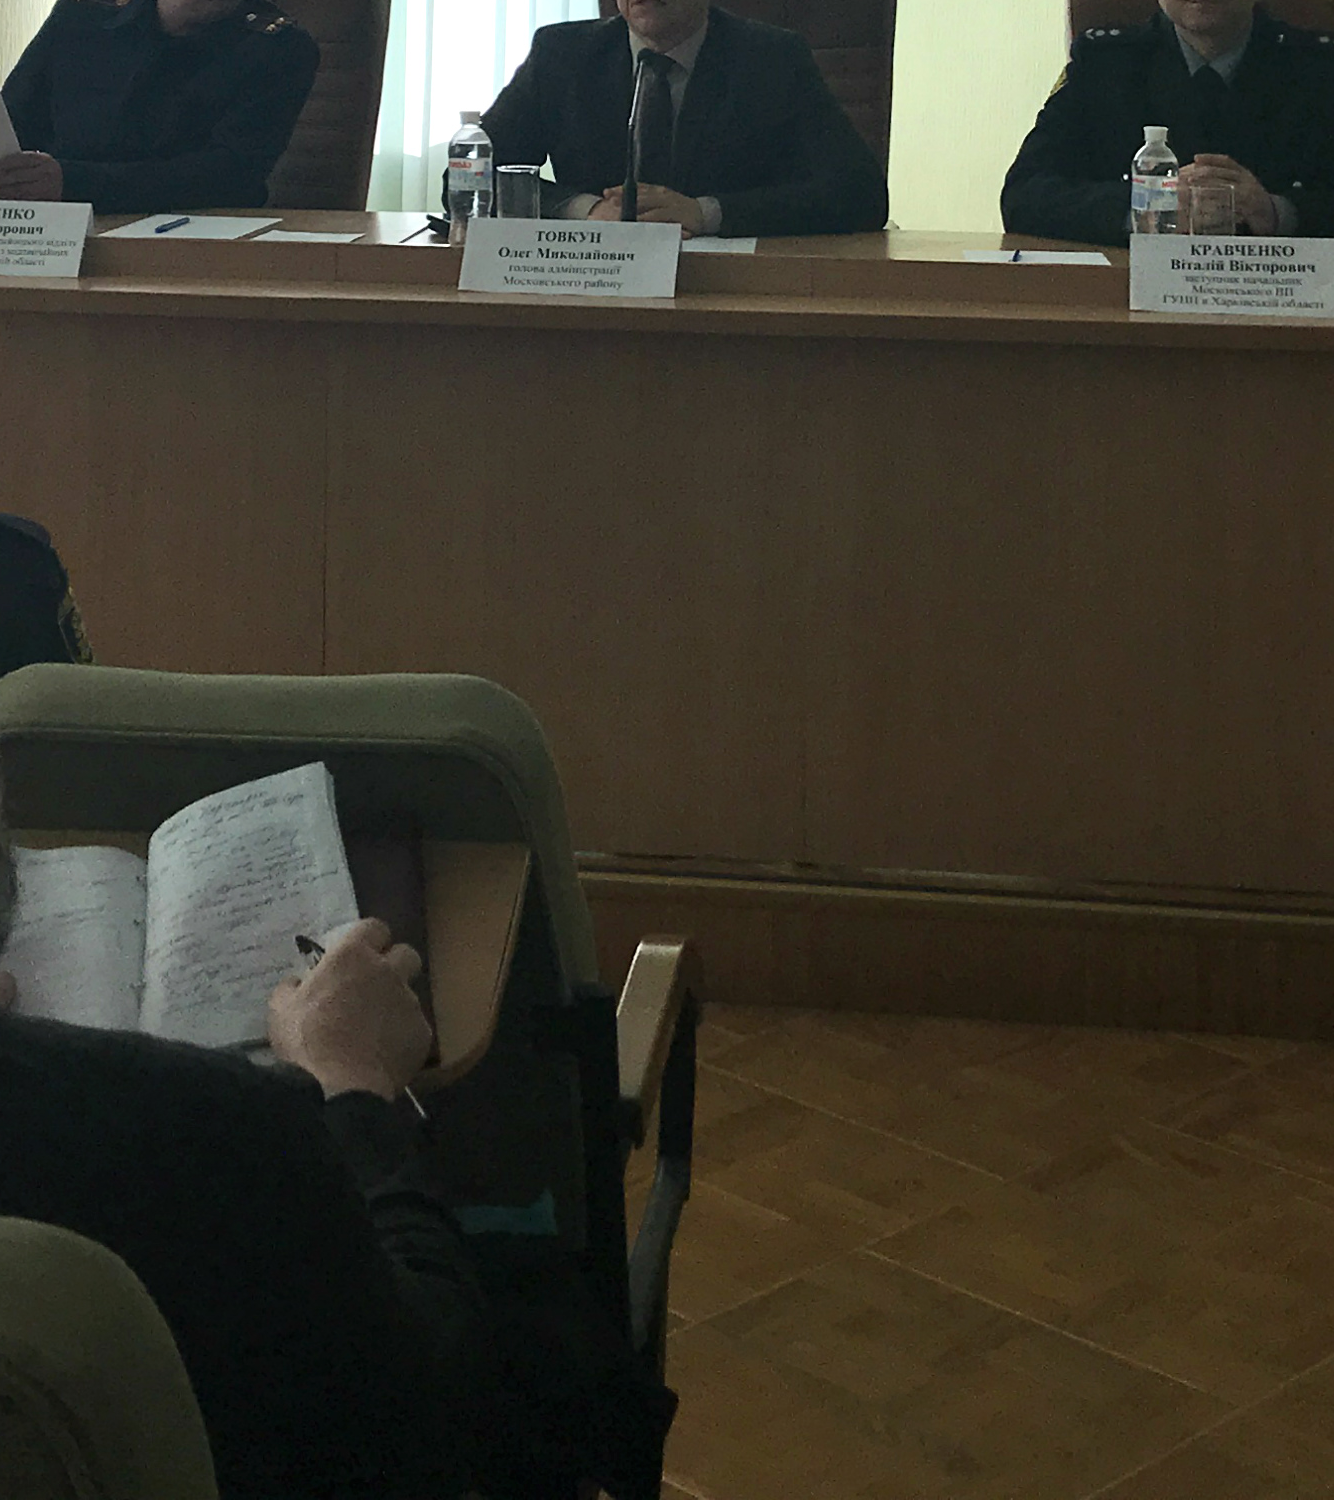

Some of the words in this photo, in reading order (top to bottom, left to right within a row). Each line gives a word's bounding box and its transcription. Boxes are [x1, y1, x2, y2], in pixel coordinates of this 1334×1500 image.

[536, 230, 602, 243] ТОВКУН
[498, 246, 532, 258] Олег
[536, 247, 635, 261] Миколайович
[1190, 244, 1295, 257] КРАВЧЕНКО
[508, 264, 545, 273] голова
[547, 265, 622, 276] адміністрації
[1171, 259, 1224, 270] Віталій
[1229, 260, 1315, 275] Вікторович
[503, 276, 581, 288] Московського
[584, 279, 624, 290] району
[1192, 285, 1272, 296] Московського
